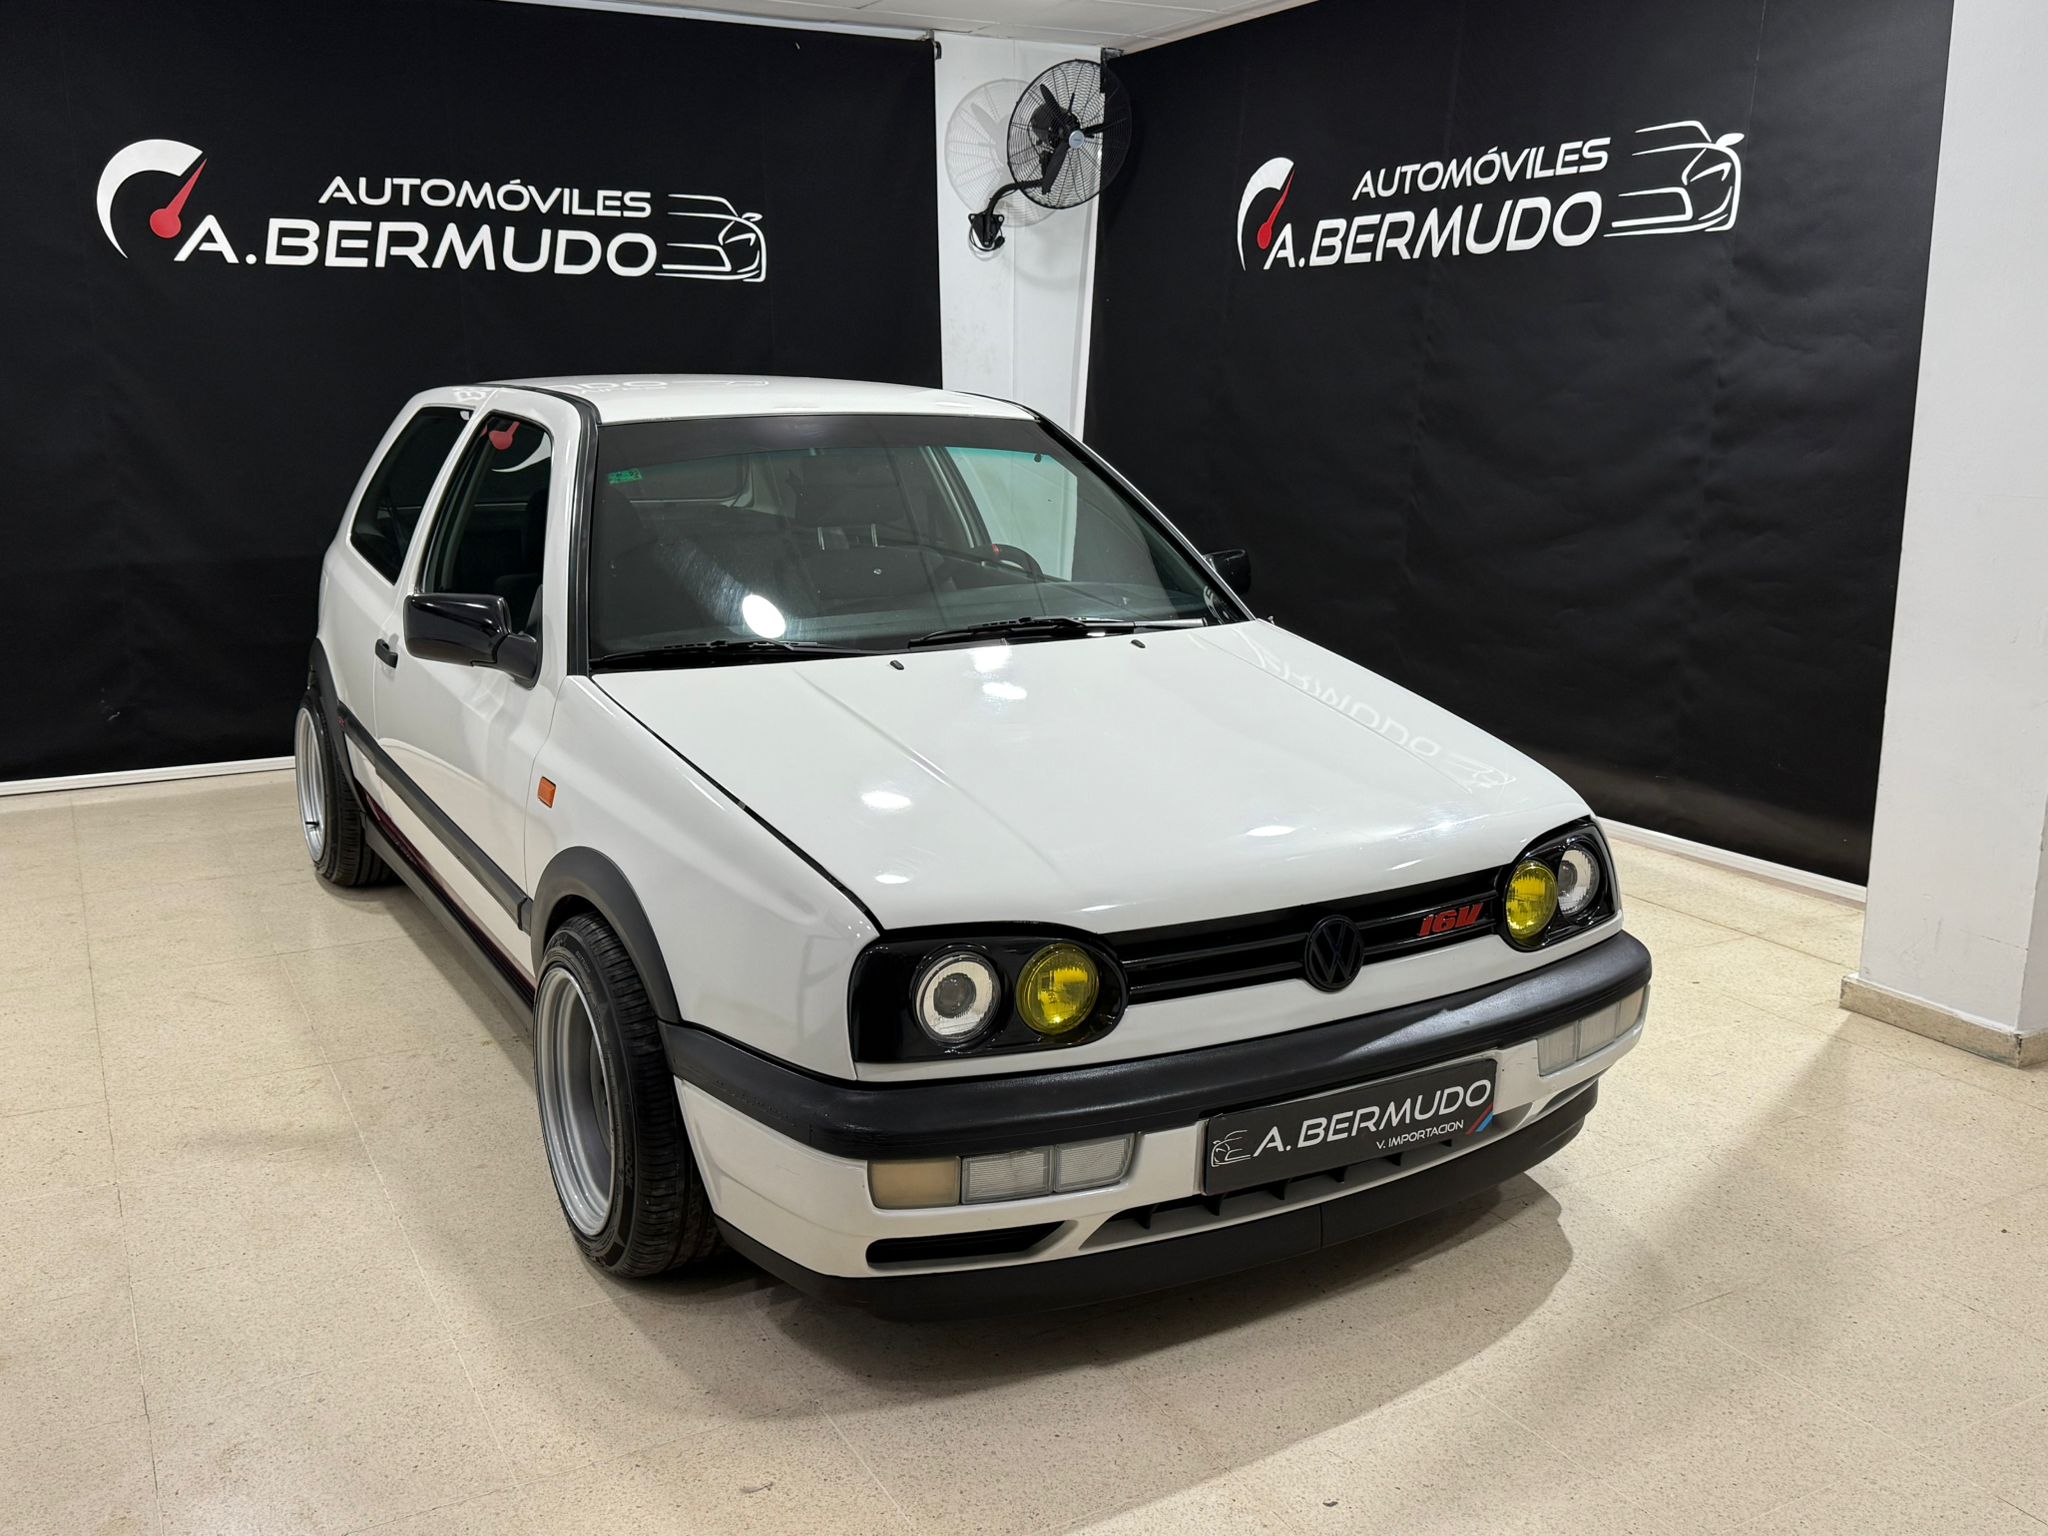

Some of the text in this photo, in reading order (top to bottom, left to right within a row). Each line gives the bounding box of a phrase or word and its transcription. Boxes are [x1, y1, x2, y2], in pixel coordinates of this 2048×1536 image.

[1351, 136, 1612, 201] AUTOMÓVILES
[318, 175, 652, 218] AUTOMÓVILES
[1263, 190, 1603, 270] A.BERMUDO
[1418, 902, 1483, 936] 16V
[1252, 1079, 1492, 1158] A.BERMUDO
[1376, 1119, 1464, 1150] V. IMPORTACION
